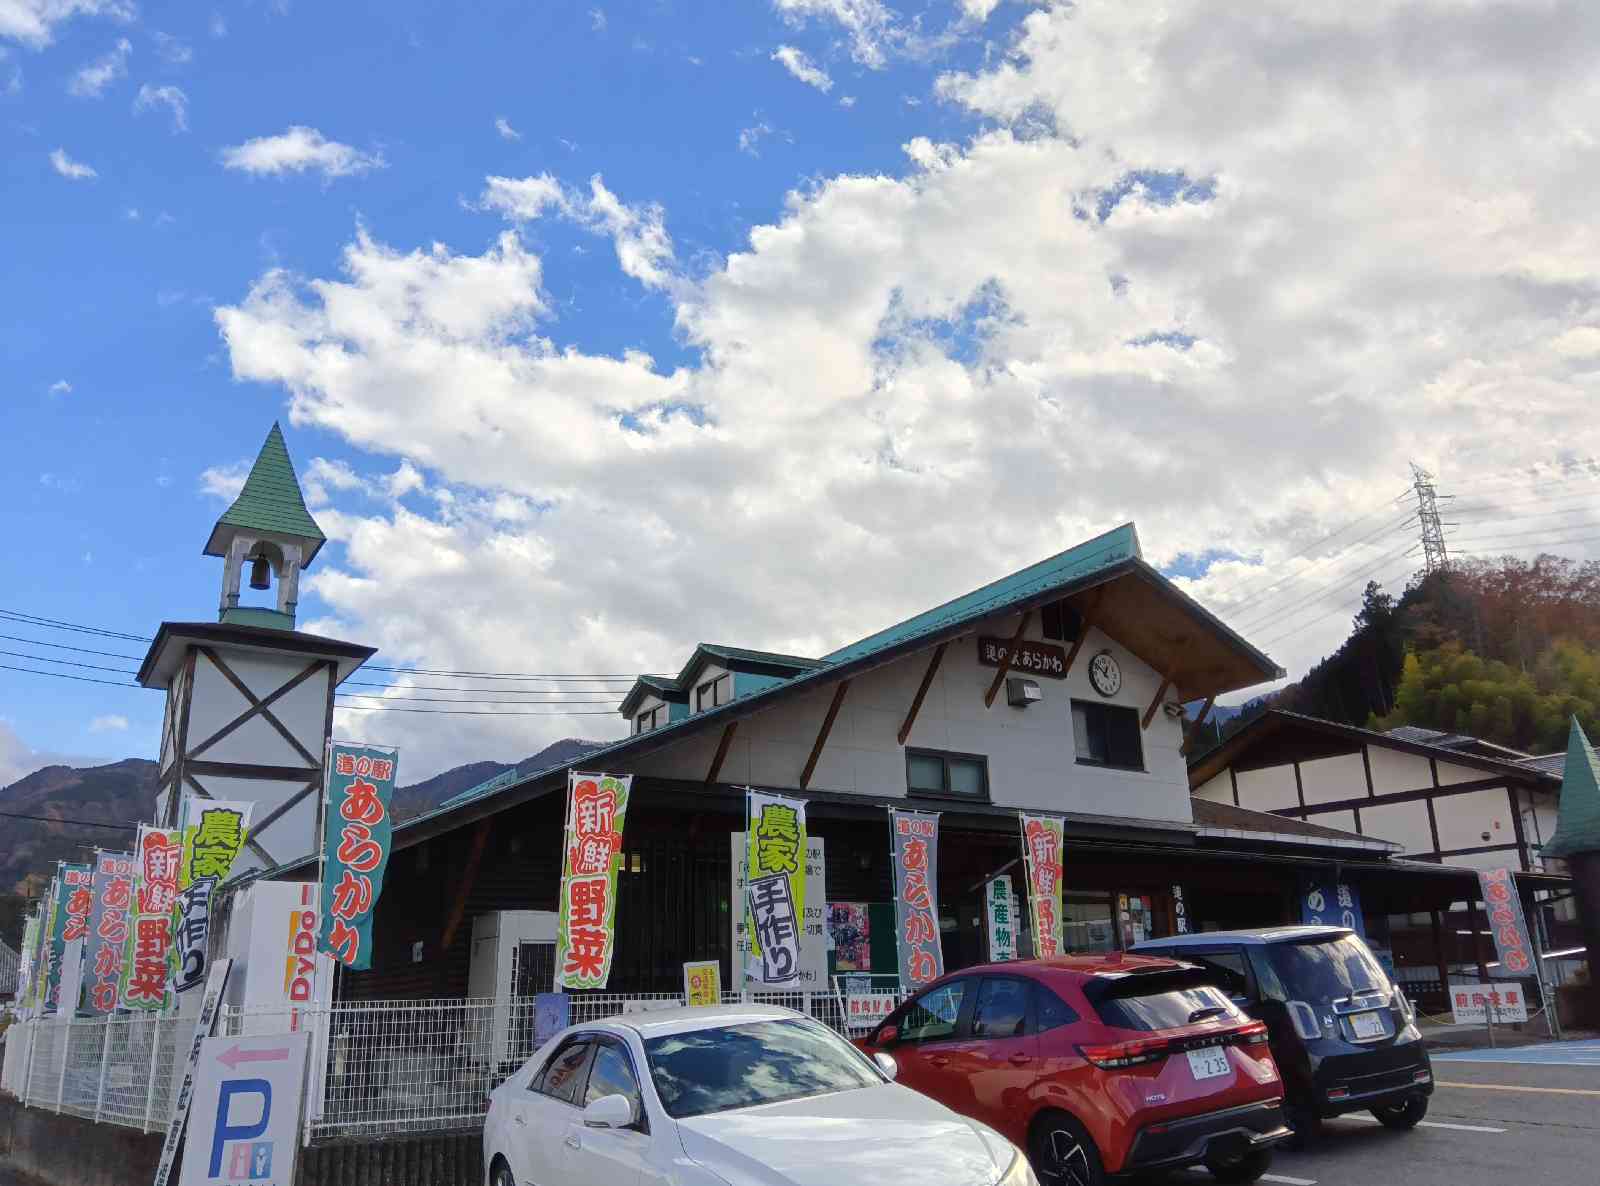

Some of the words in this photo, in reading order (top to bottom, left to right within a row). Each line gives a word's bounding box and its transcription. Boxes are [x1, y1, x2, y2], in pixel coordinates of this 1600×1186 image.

[337, 753, 391, 780] 道の駅
[194, 808, 242, 879] 農家
[327, 778, 385, 964] あらかわ
[566, 790, 616, 978] 新鮮野菜
[758, 804, 799, 872] 農家
[93, 874, 131, 1013] あらかわ
[756, 880, 794, 977] 手作り
[902, 836, 936, 983] あらかわ
[208, 1078, 272, 1179] P
